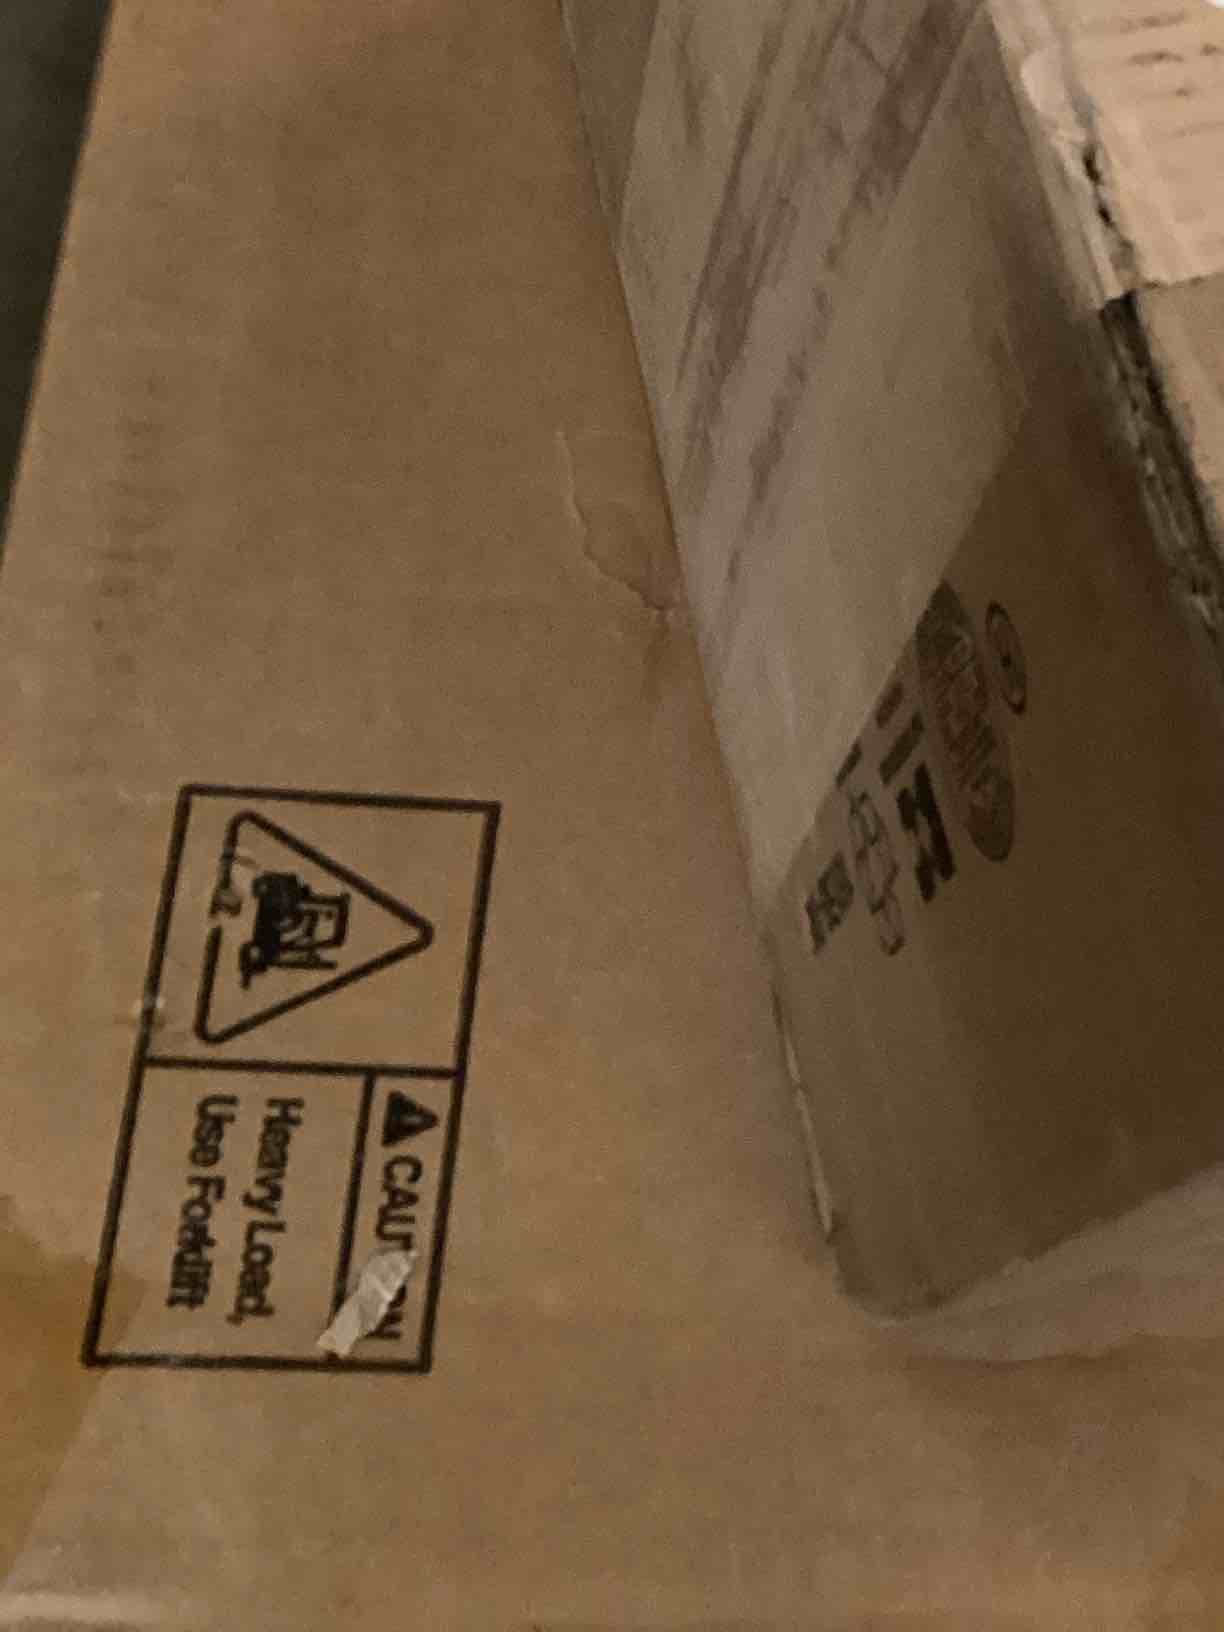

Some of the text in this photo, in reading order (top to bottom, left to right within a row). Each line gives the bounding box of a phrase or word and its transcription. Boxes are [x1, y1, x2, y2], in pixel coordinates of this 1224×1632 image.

[188, 1094, 239, 1168] Use
[241, 1097, 305, 1216] Heavy
[358, 1154, 423, 1340] CAUN
